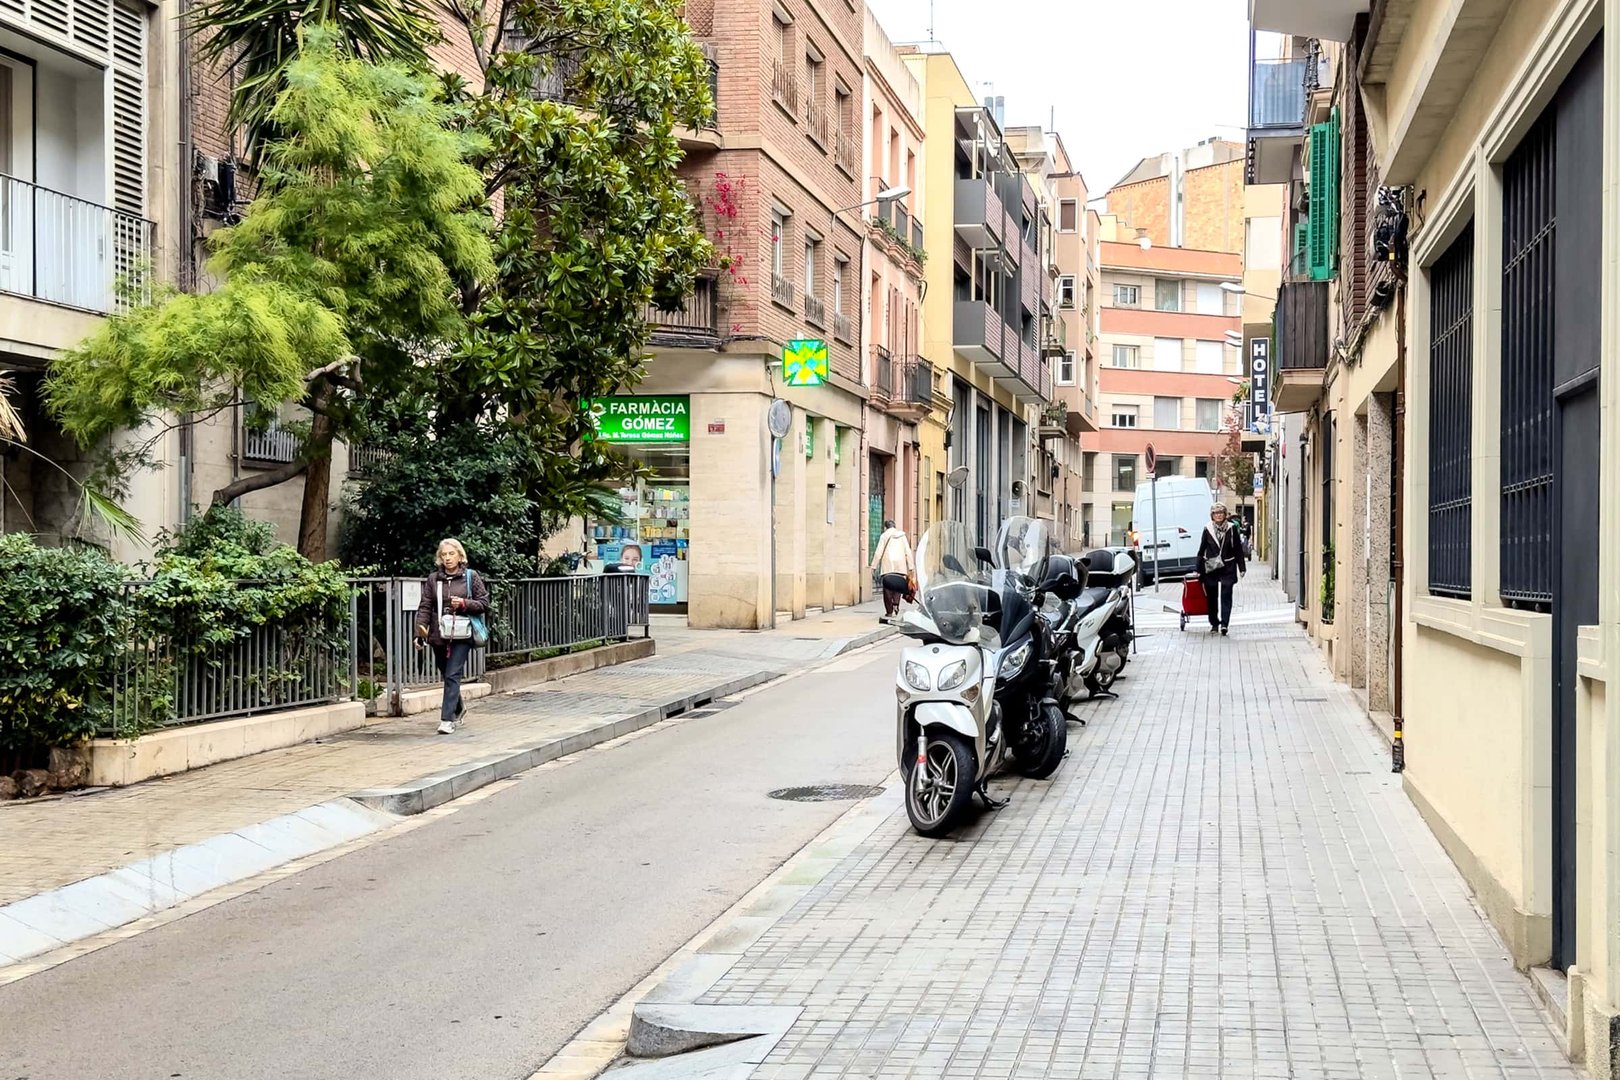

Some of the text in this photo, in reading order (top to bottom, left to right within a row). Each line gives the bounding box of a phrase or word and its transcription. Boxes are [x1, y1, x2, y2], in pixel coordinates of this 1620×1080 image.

[1253, 343, 1266, 417] HOTEL
[610, 400, 685, 414] FARMÀCIA
[621, 415, 674, 430] GÓMEZ
